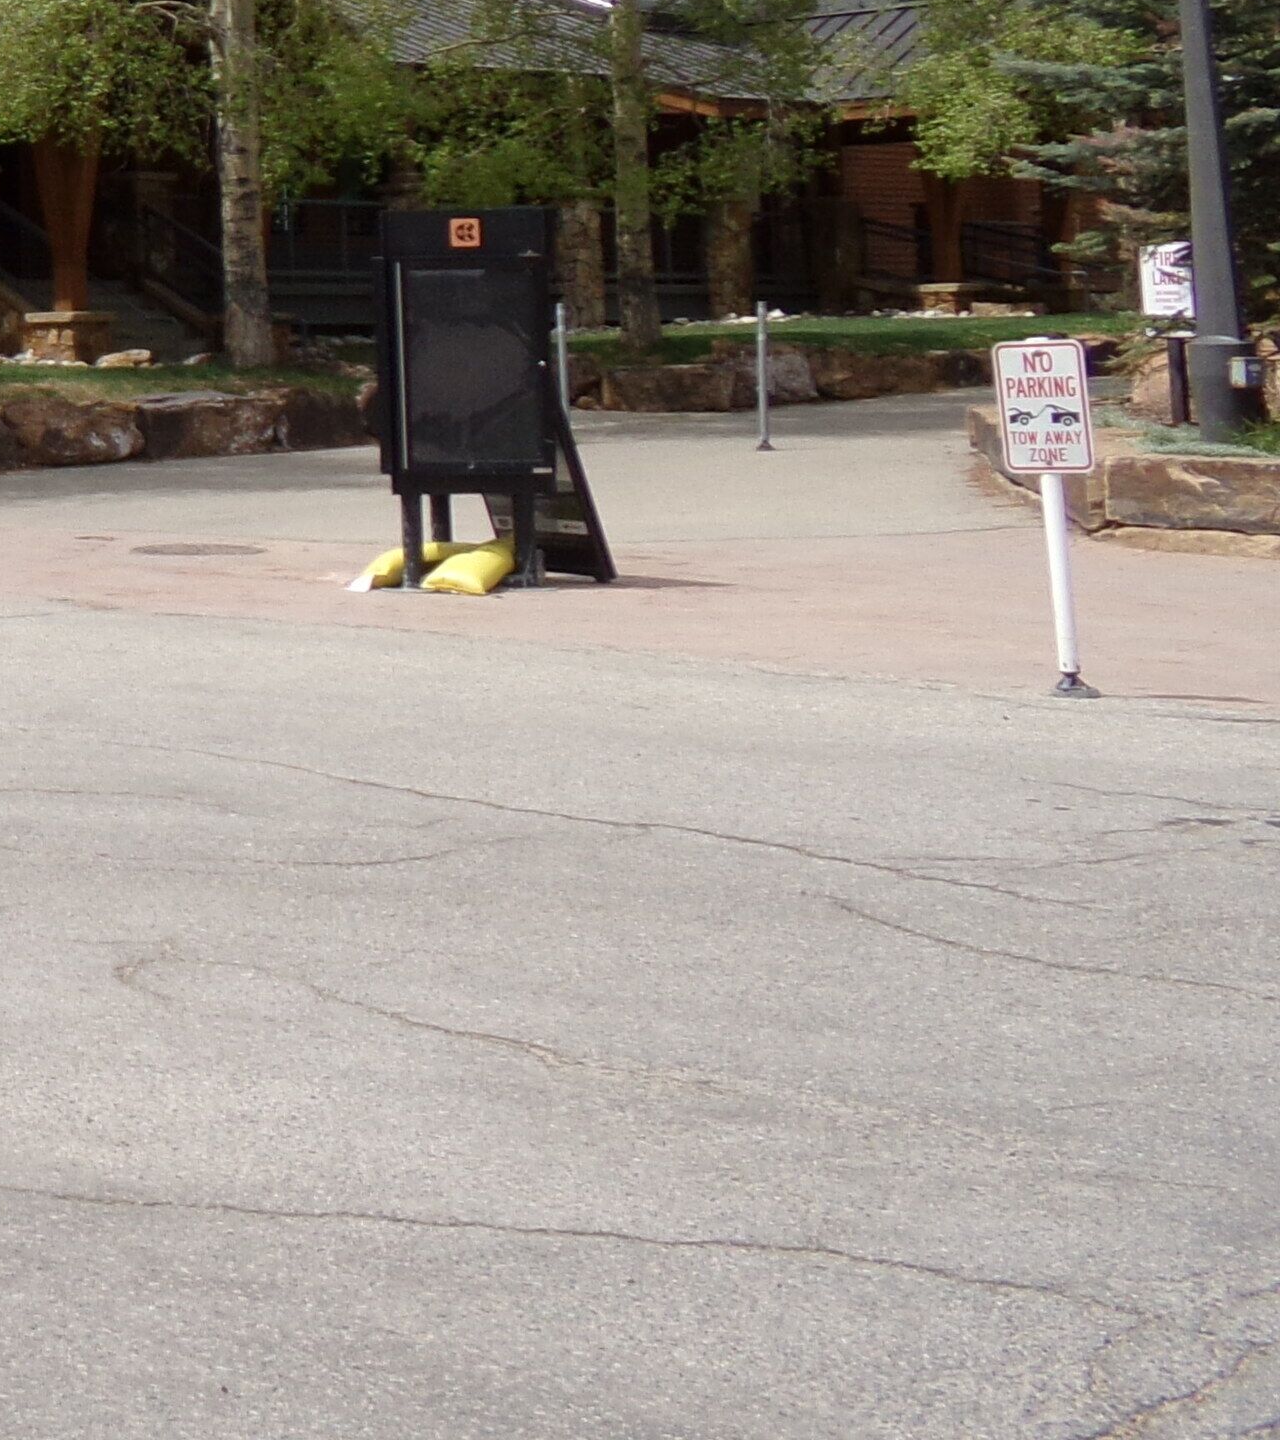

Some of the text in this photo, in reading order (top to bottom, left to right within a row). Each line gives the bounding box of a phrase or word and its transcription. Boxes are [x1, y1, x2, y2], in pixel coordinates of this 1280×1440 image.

[1022, 351, 1053, 373] NO
[1005, 376, 1077, 398] PARKING
[1010, 430, 1082, 445] TOW AWAY
[1028, 448, 1068, 463] ZONE
